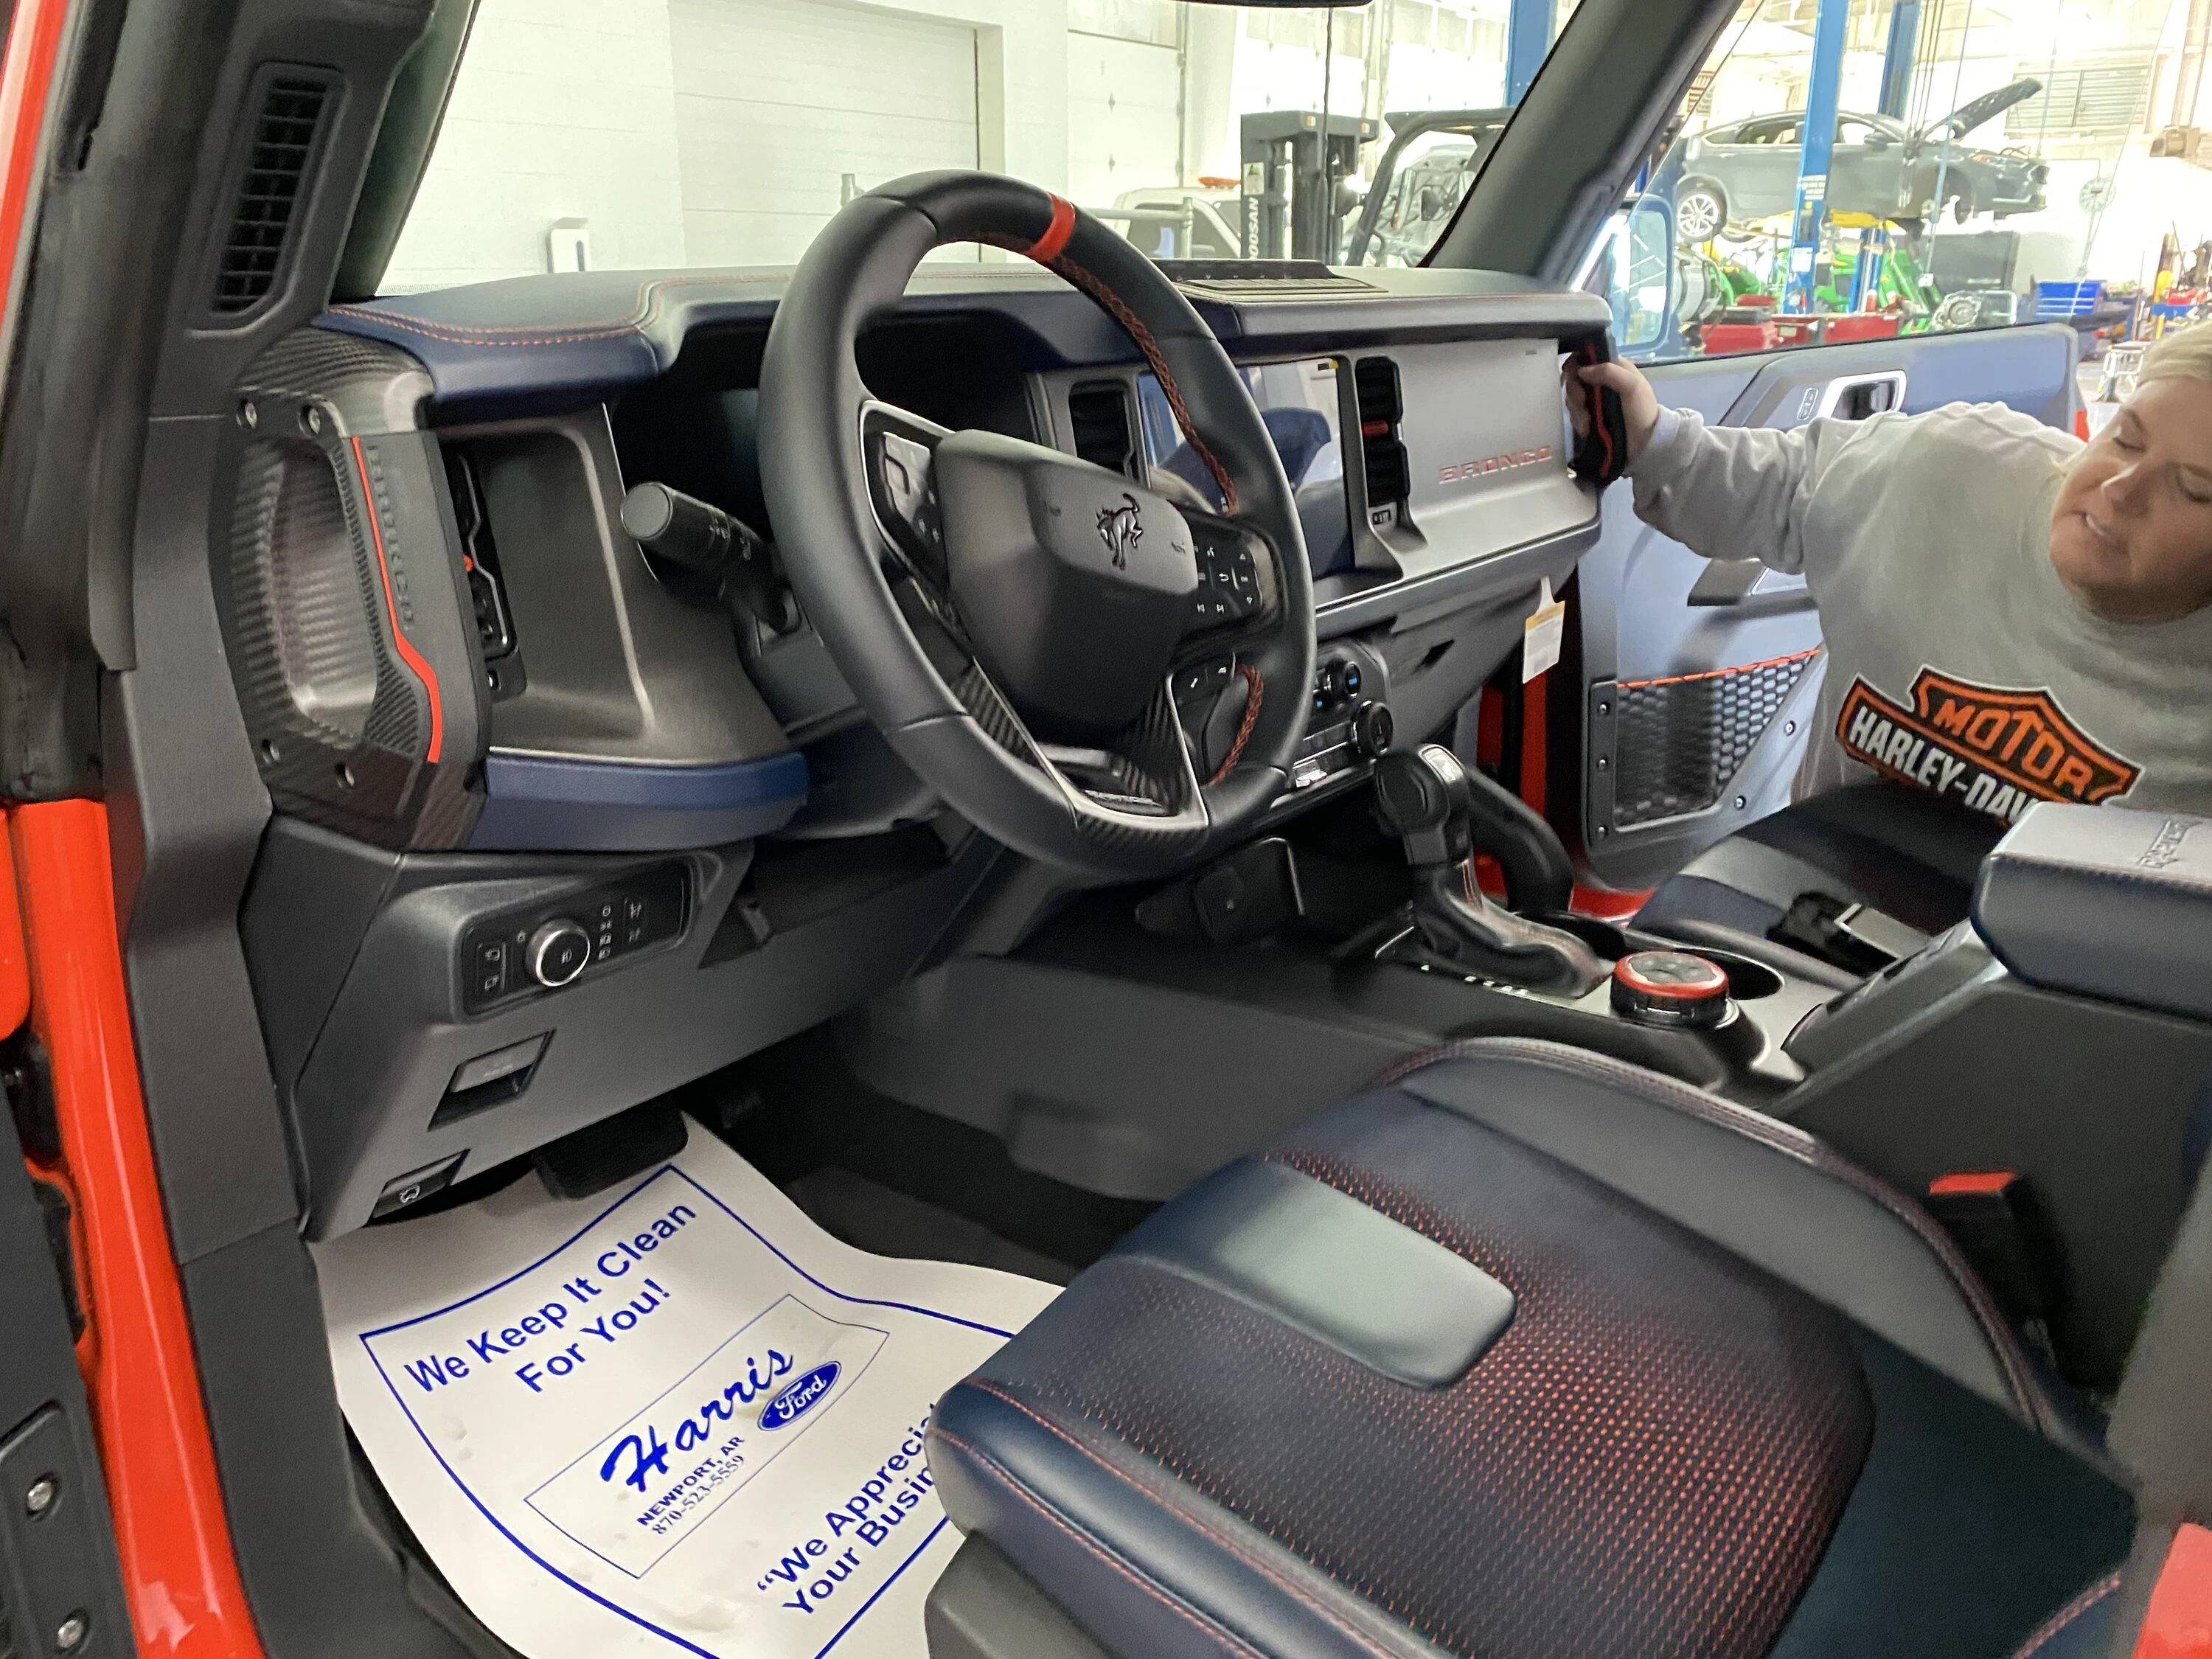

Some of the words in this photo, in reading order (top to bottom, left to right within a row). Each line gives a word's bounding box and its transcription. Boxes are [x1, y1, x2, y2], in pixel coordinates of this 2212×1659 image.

[1248, 196, 1259, 259] OOSAN
[1439, 445, 1552, 484] BRONCO
[1934, 698, 2095, 797] MOTOR
[403, 1354, 470, 1393] We
[466, 1299, 568, 1363] Keep
[563, 1276, 602, 1304] It
[597, 1203, 697, 1279] Clean
[515, 1343, 588, 1393] For
[580, 1278, 671, 1344] You!
[600, 1347, 795, 1492] Harris
[774, 1376, 827, 1420] Ford
[636, 1458, 723, 1526] NEWPORT,
[720, 1436, 745, 1457] AR
[652, 1455, 745, 1534] 870-523-5559
[757, 1537, 830, 1593] “We
[782, 1546, 861, 1617] Your
